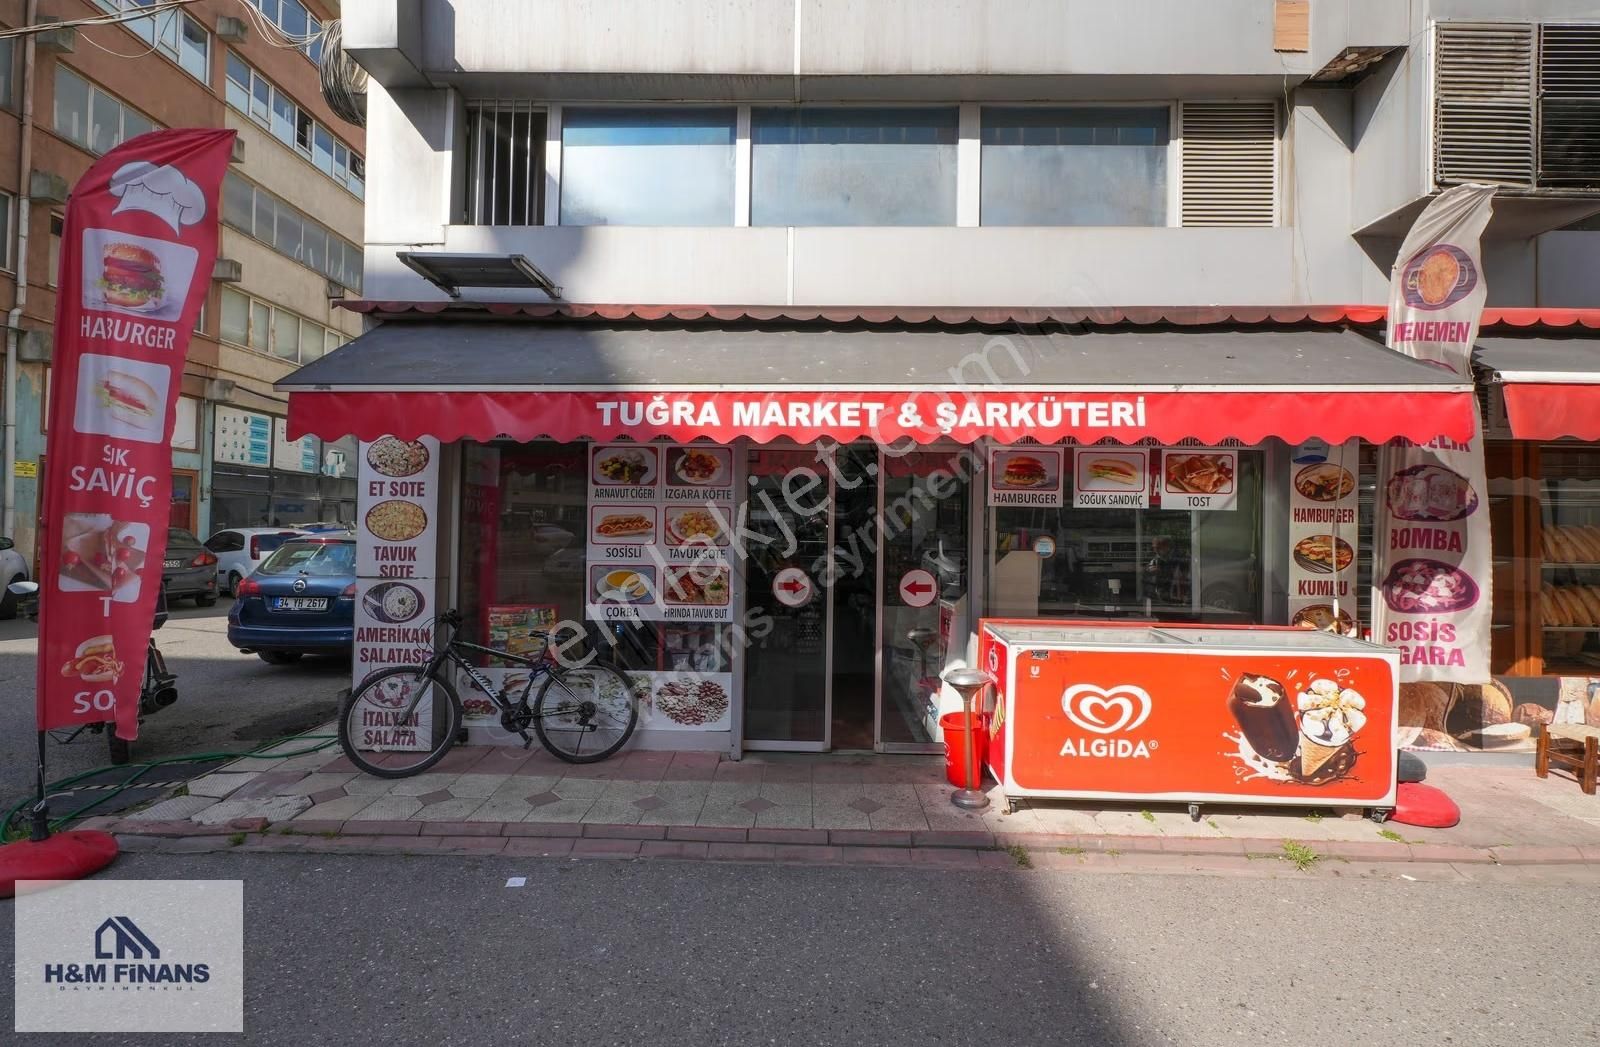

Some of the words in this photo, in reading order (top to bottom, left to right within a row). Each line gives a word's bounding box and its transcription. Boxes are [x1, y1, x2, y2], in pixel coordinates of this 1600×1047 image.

[596, 396, 721, 427] TUĞRA
[732, 401, 883, 427] MARKET
[898, 401, 923, 427] &
[936, 396, 1148, 433] ŞARKÜTERİ
[369, 481, 385, 497] ET
[389, 481, 425, 497] SOTE
[594, 489, 631, 499] ARNAVUT
[631, 486, 655, 499] CİĞERİ
[665, 488, 699, 499] IZGARA
[702, 487, 732, 500] KÖFTE
[993, 493, 1057, 505] HAMBURGER
[1079, 492, 1106, 505] SOĞUK
[1108, 492, 1143, 507] SANDVİÇ
[1187, 496, 1216, 507] TOST
[1293, 508, 1355, 523] HAMBURGER
[1391, 527, 1461, 552] BOMBA
[373, 545, 417, 561] TAVUK
[606, 545, 642, 558] SOSİSLİ
[669, 548, 700, 559] TAVUK
[702, 548, 726, 559] SOTE
[380, 565, 414, 578] SOTE
[280, 598, 289, 608] 34
[306, 597, 326, 608] 2617
[606, 607, 640, 620] ÇORBA
[692, 608, 713, 619] TAVUK
[715, 608, 728, 619] BUT
[356, 624, 431, 643] AMERİKAN
[1387, 618, 1457, 643] SOSİS
[363, 730, 417, 746] SALATA
